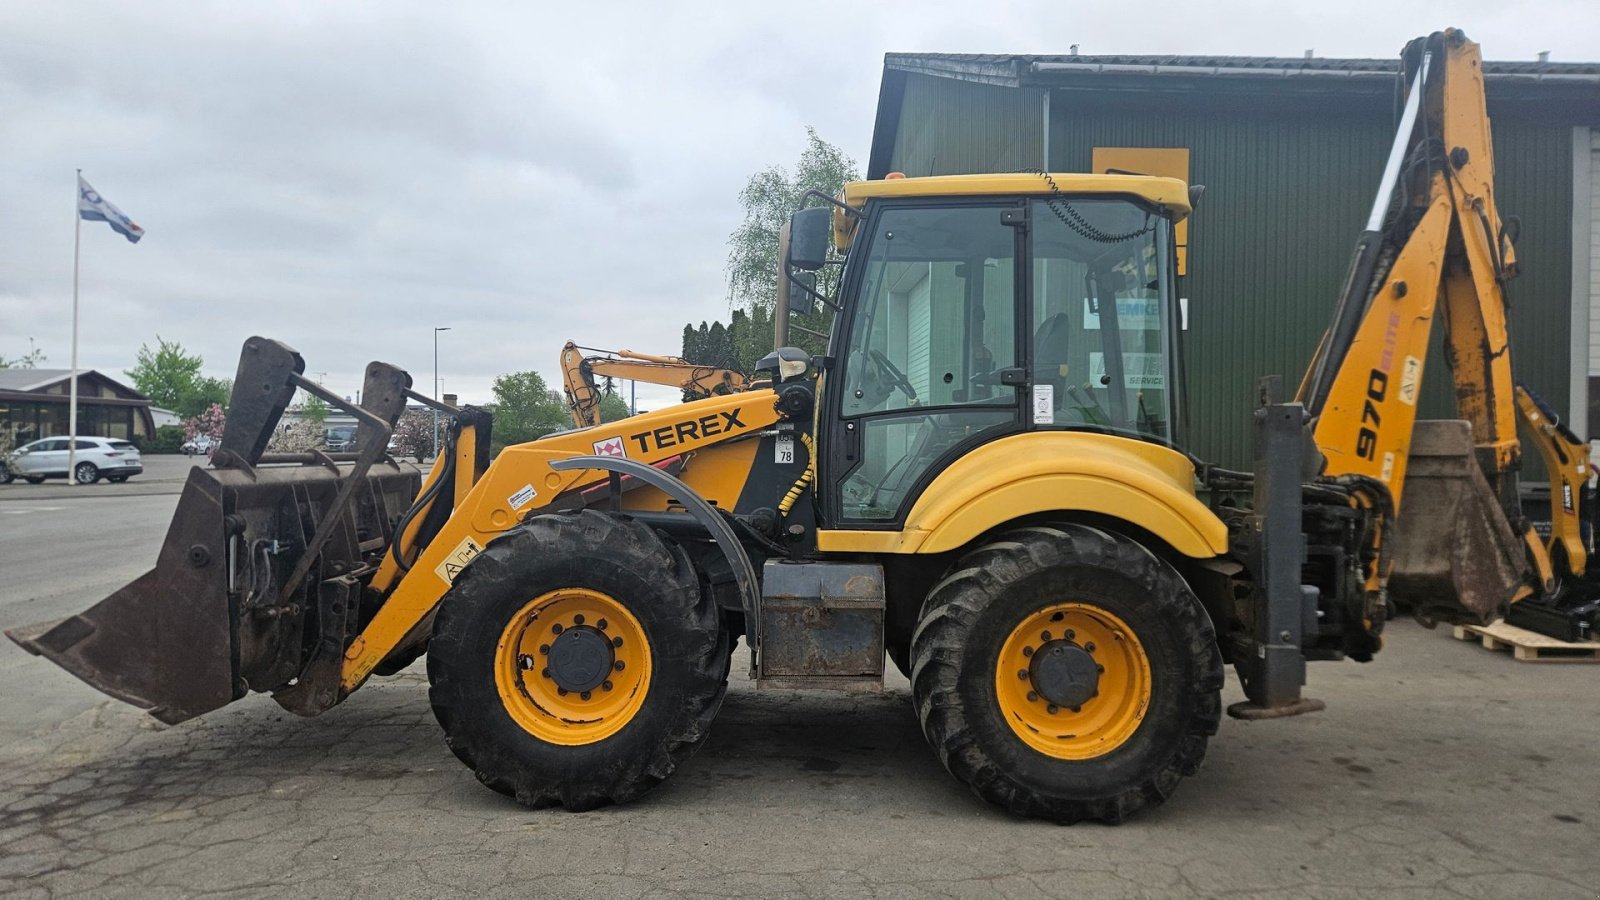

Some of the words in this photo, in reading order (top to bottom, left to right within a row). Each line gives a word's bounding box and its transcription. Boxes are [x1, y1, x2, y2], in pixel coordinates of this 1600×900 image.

[1129, 377, 1164, 385] SERVICE
[1356, 368, 1389, 462] 970
[1380, 312, 1400, 371] ELITE
[630, 407, 747, 454] TEREX
[780, 451, 792, 462] 78
